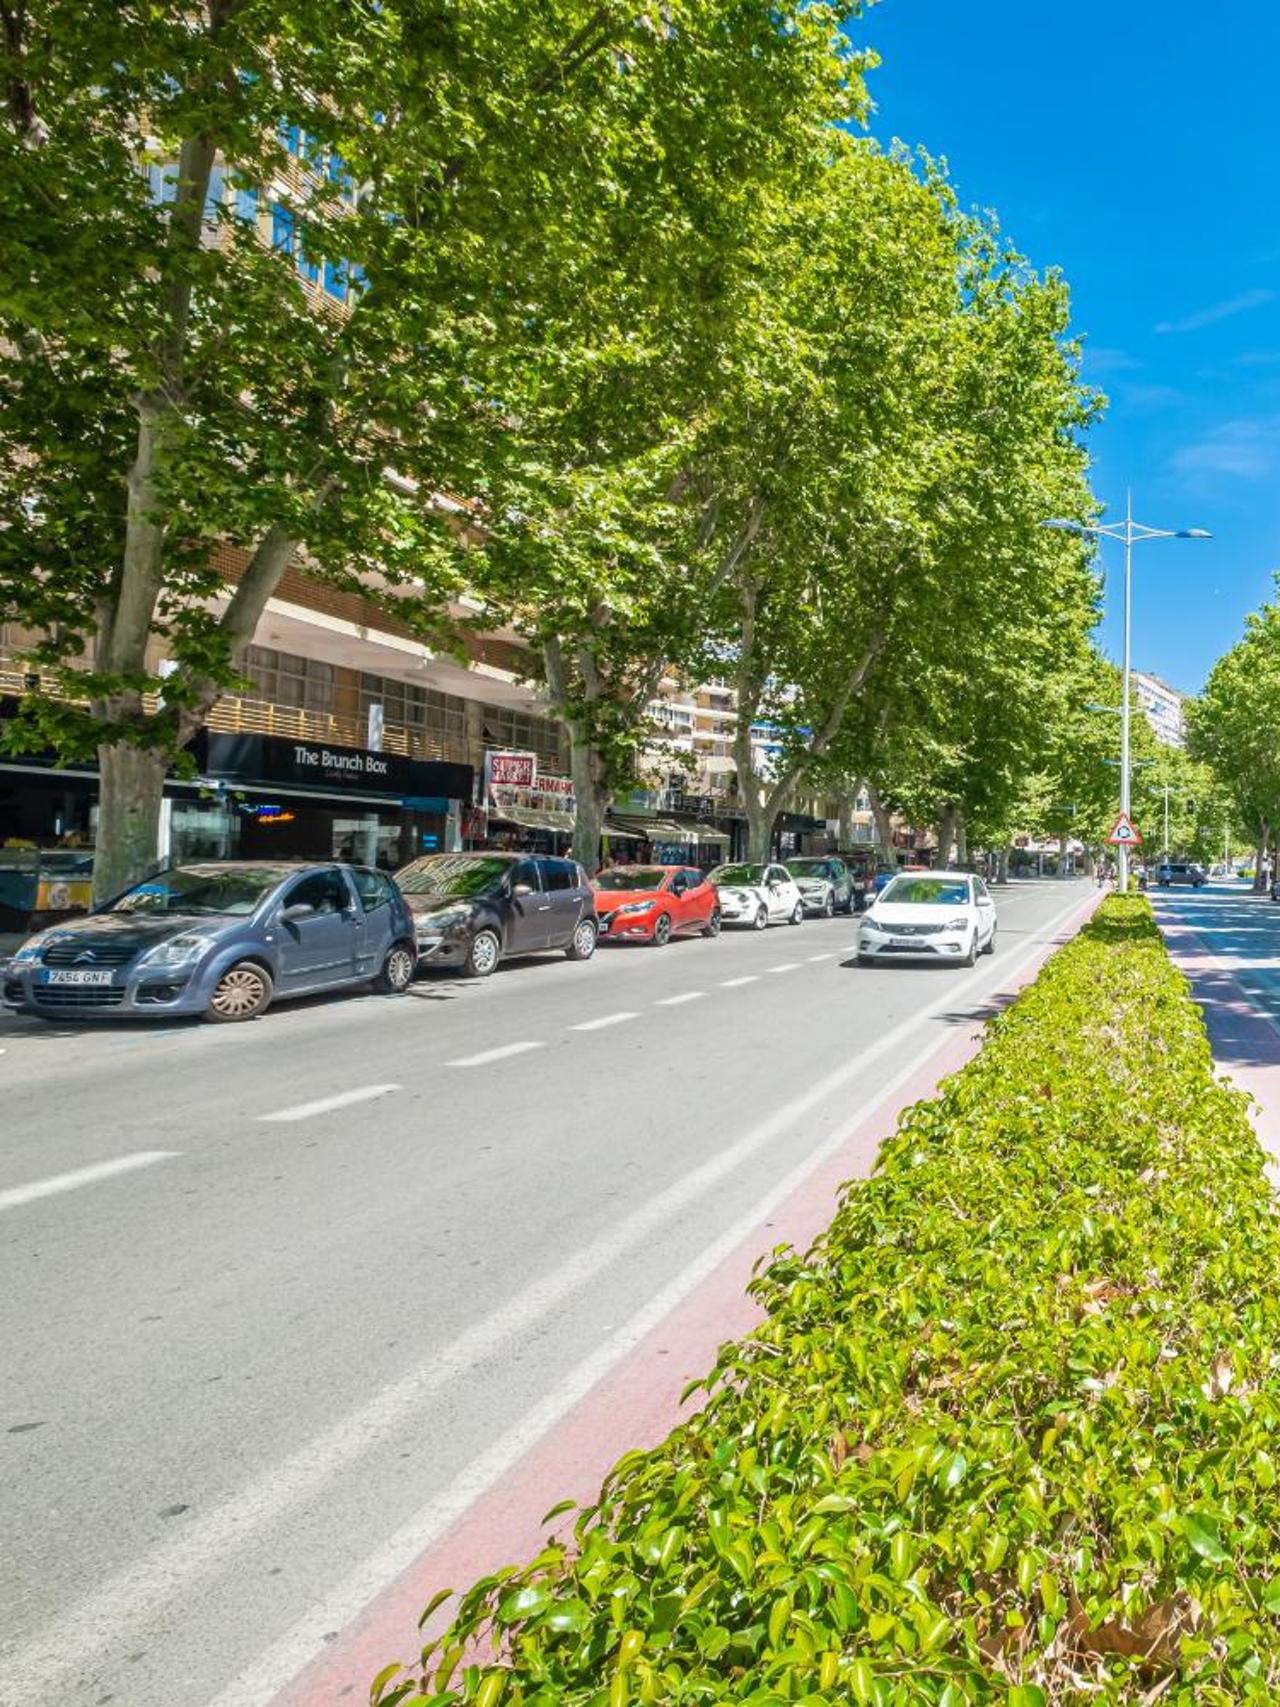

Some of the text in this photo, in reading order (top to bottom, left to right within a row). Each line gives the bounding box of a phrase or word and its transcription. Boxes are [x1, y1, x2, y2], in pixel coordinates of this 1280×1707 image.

[294, 746, 387, 774] The Brunch Box
